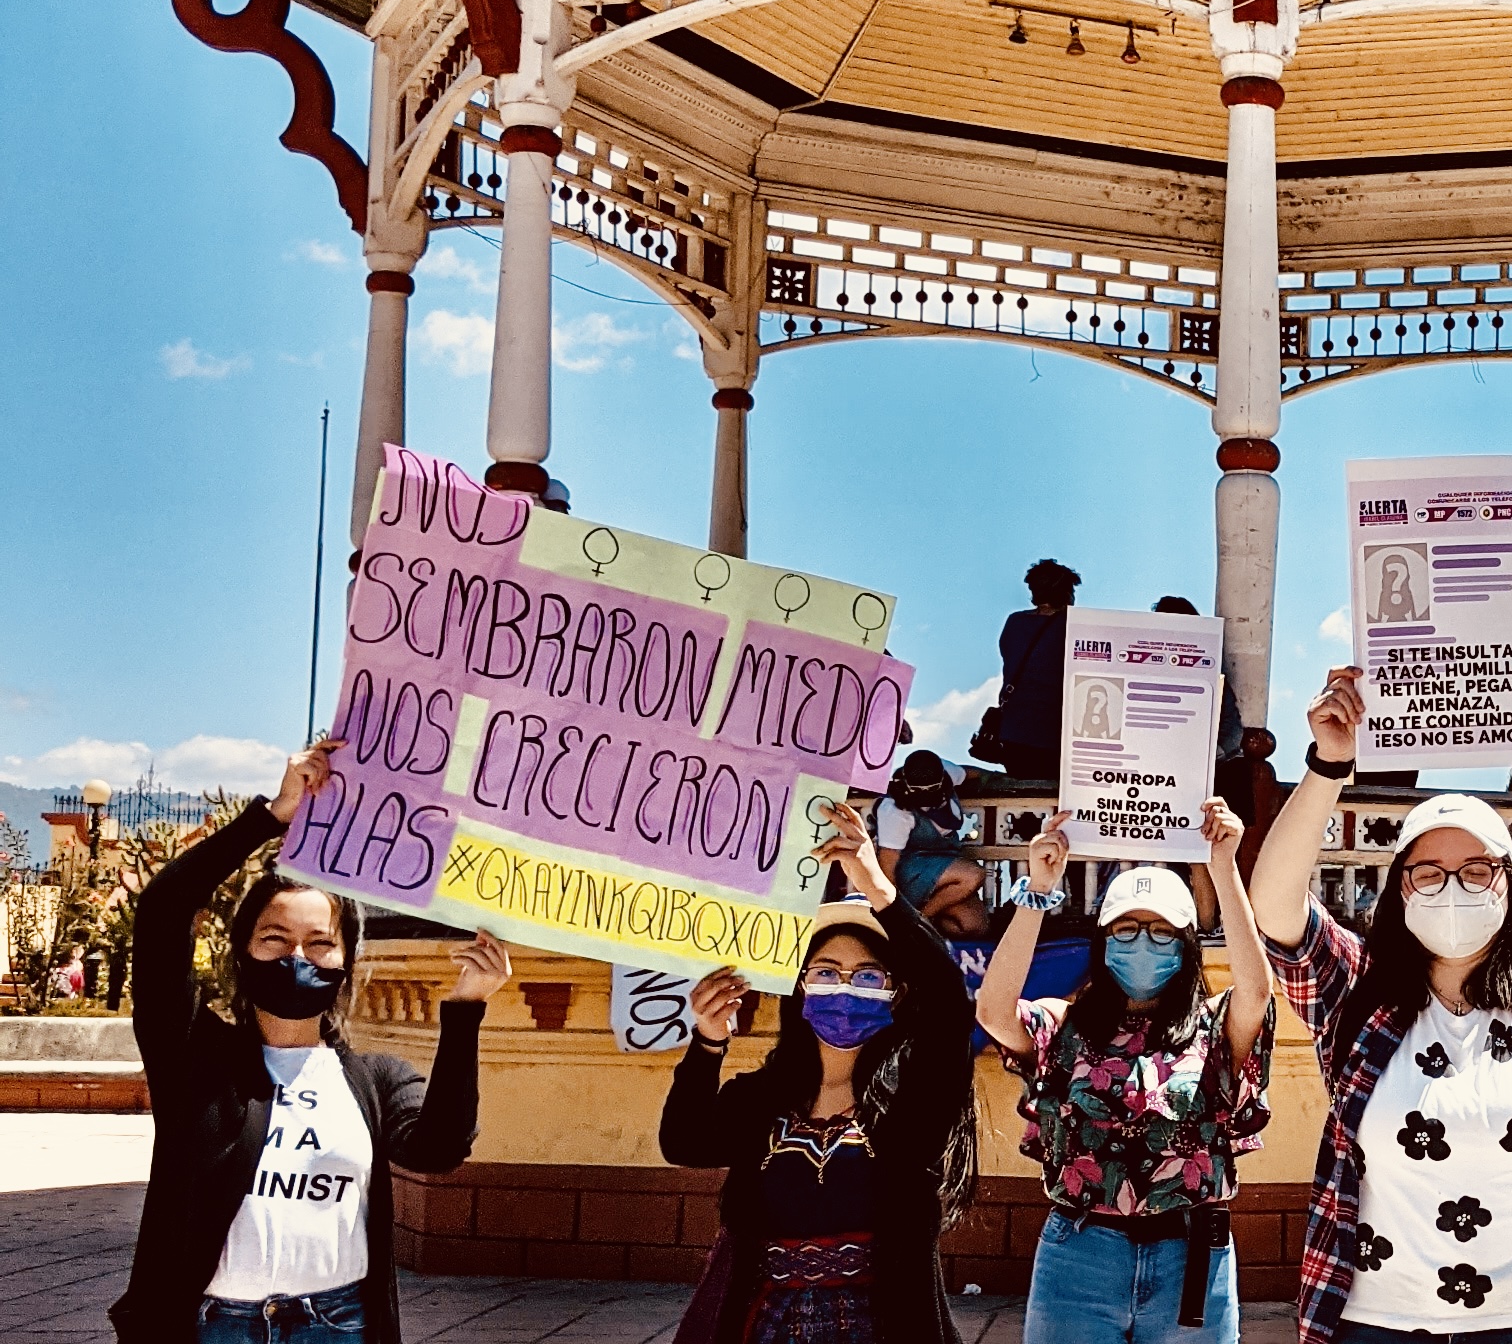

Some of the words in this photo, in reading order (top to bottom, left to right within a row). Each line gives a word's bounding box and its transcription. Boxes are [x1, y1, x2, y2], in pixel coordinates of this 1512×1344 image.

[1360, 499, 1407, 515] ALERTA
[1074, 640, 1112, 655] ALERTA
[1388, 649, 1403, 662] SI
[1408, 647, 1430, 662] TE
[350, 552, 723, 728] SEMBRARON
[721, 644, 902, 771] MIEDO
[1376, 664, 1440, 680] ATACA,
[1380, 680, 1460, 697] RETIENE,
[1466, 679, 1512, 694] PEGA
[1407, 696, 1500, 712] AMENAZA,
[1368, 717, 1394, 731] NO
[1400, 716, 1421, 730] TE
[1376, 733, 1416, 748] ¡ESO
[1421, 732, 1447, 746] NO
[1453, 731, 1474, 744] ES
[341, 669, 453, 775] NOS
[474, 711, 790, 872] CRECIERON
[1092, 770, 1128, 784] CON
[1130, 773, 1176, 787] ROPA
[1127, 786, 1139, 799] O
[1097, 798, 1122, 810] SIN
[1125, 799, 1171, 814] ROPA
[1076, 809, 1096, 822] MI
[1101, 812, 1163, 827] CUERPO
[1165, 815, 1190, 828] NO
[289, 771, 449, 890] ALAS
[1099, 826, 1117, 838] SE
[1120, 827, 1165, 841] TOCA
[276, 1084, 318, 1110] ES
[294, 1127, 321, 1150] A
[257, 1170, 354, 1203] INIST
